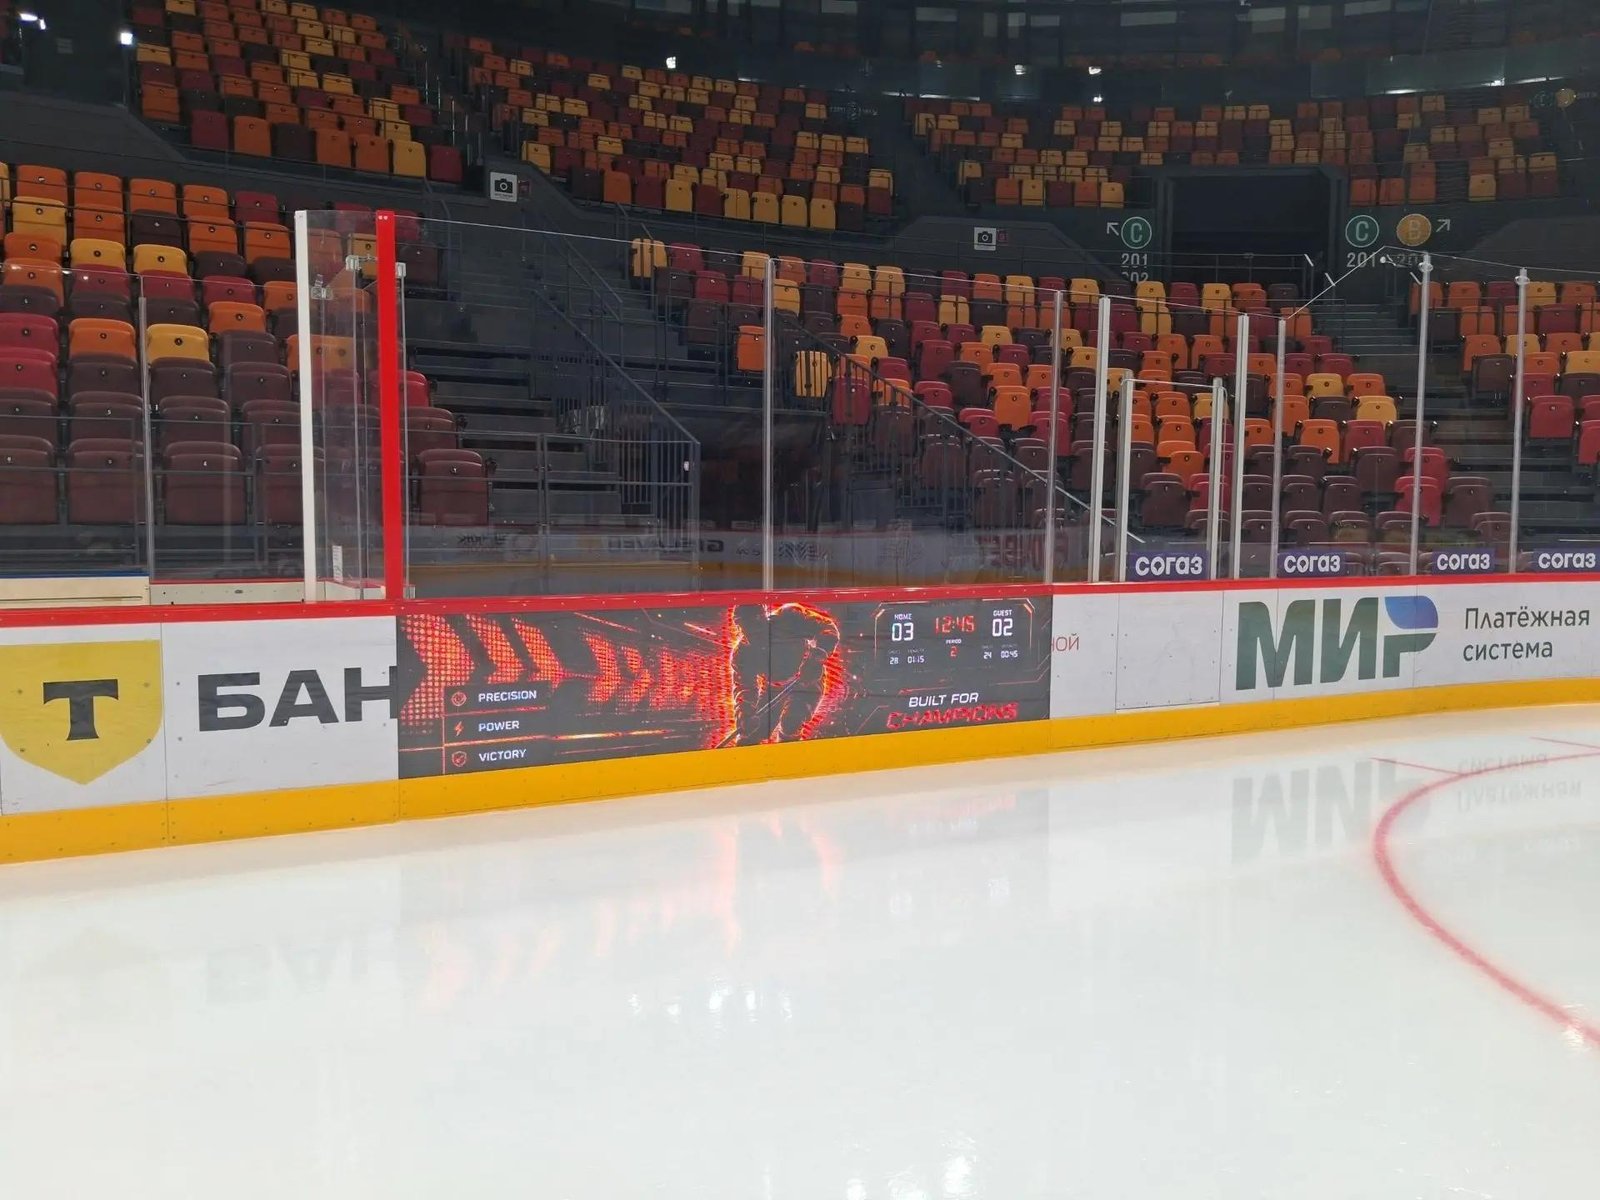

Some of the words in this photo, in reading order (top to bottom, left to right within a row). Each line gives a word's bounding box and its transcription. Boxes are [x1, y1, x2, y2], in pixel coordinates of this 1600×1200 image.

[1121, 253, 1148, 269] 201
[993, 609, 1012, 617] GUEST
[1464, 607, 1590, 630] Платёжная
[891, 622, 914, 641] 03
[935, 615, 975, 633] 12:45
[992, 618, 1013, 637] 02
[1236, 595, 1438, 690] МИР
[950, 646, 958, 657] 2
[983, 651, 992, 659] 24
[1462, 641, 1553, 662] система
[478, 690, 537, 702] PRECISION
[908, 694, 946, 708] BUILT
[950, 692, 979, 704] FOR
[478, 720, 520, 732] POWER
[478, 749, 527, 762] VICTORY
